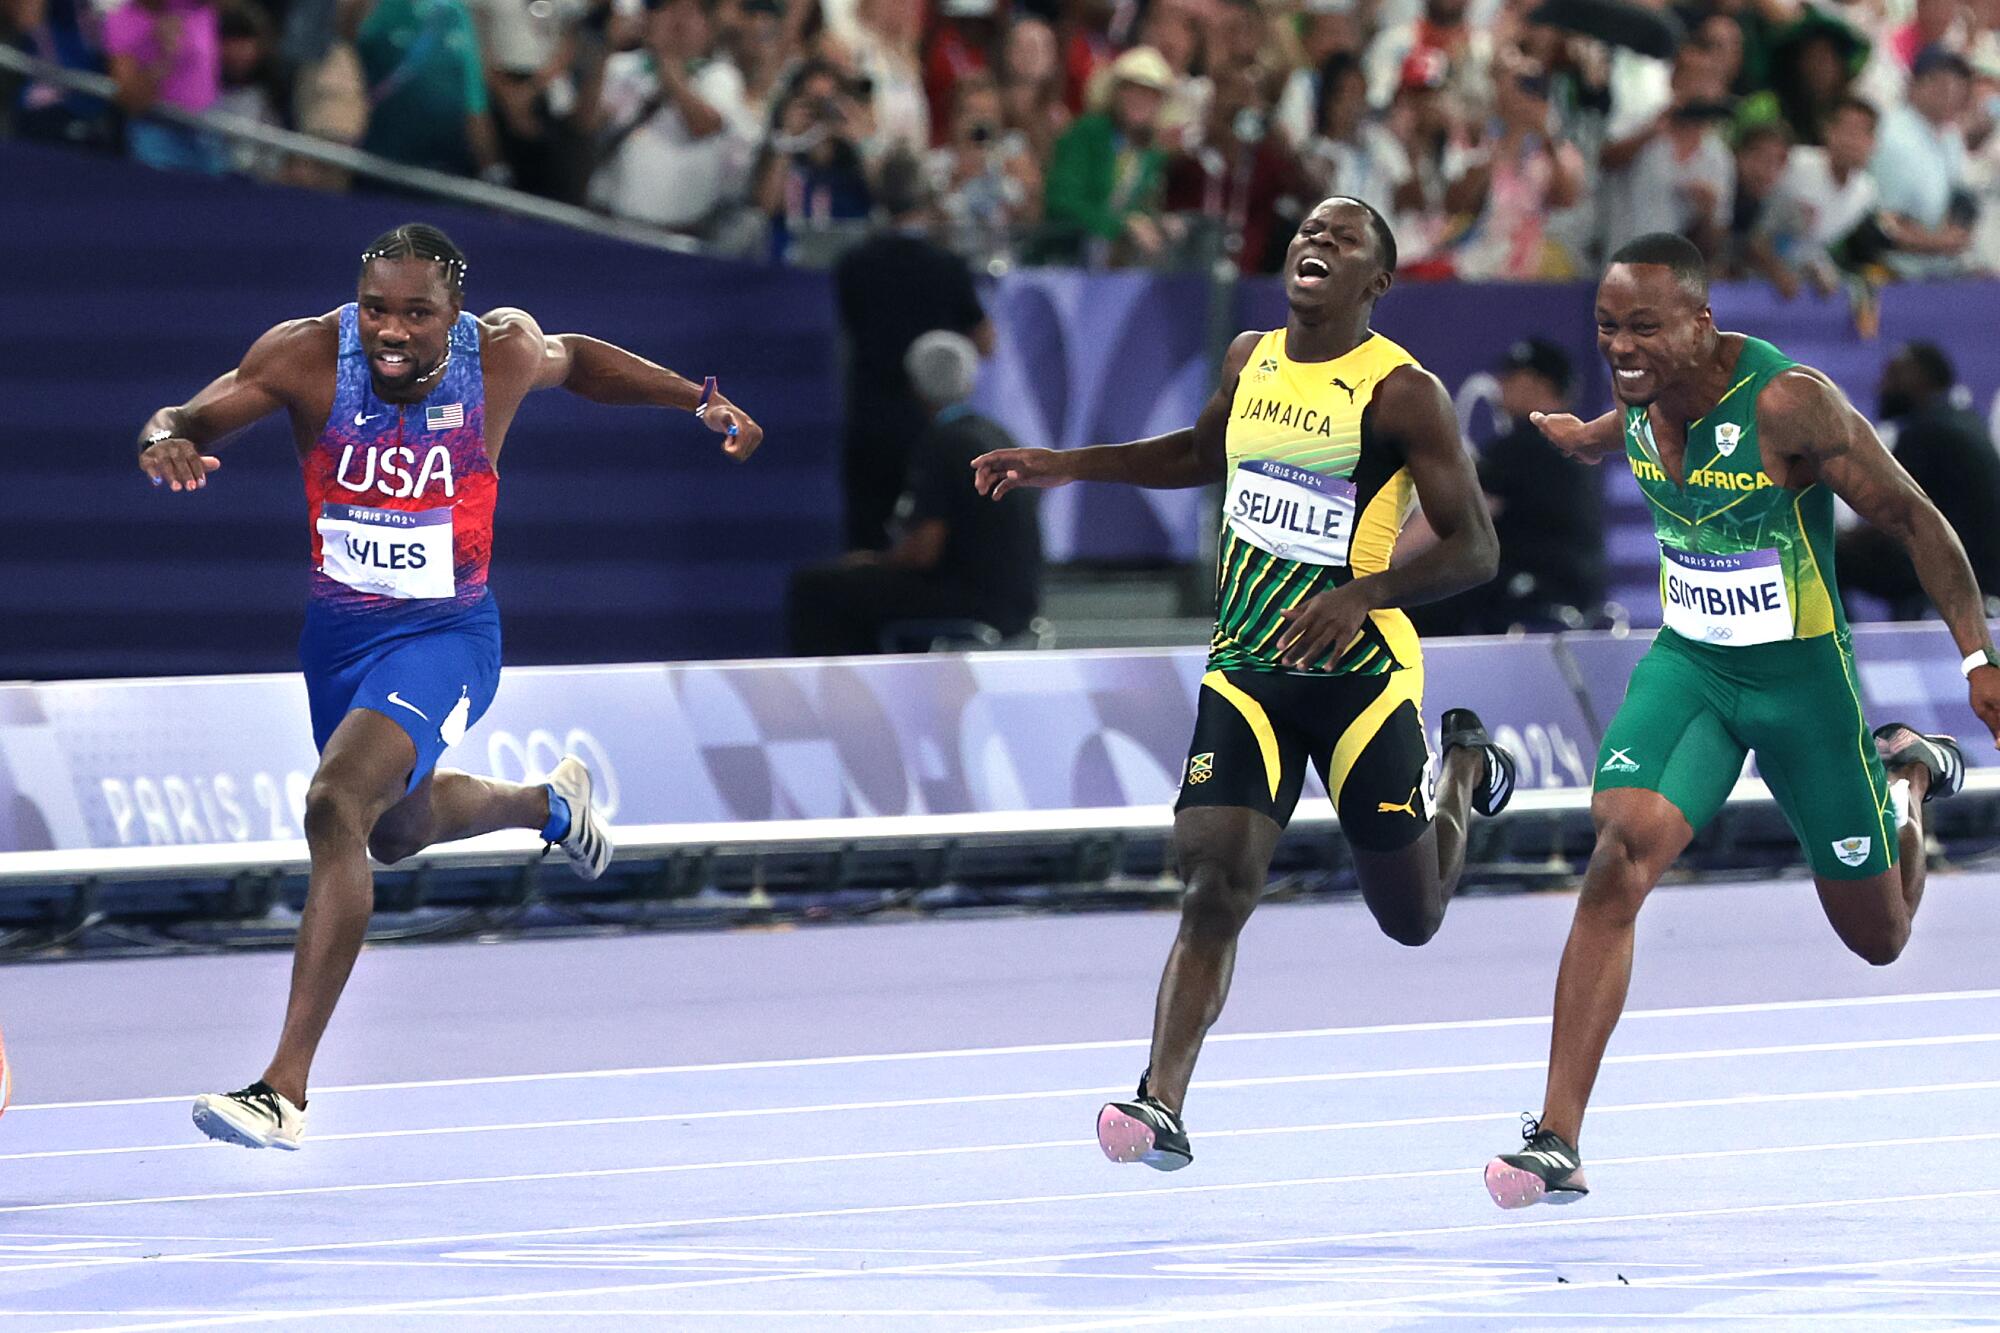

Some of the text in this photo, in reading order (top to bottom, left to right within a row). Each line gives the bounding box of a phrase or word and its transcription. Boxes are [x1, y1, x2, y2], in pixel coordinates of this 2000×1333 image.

[1240, 397, 1331, 437] JAMAICA
[336, 444, 455, 499] USA
[1262, 461, 1322, 486] PARIS 2024
[1685, 469, 1775, 491] AFRICA
[348, 509, 416, 525] PARIS 2024
[1233, 489, 1343, 539] SEVILLE
[1679, 554, 1741, 568] PARIS 2024
[1668, 574, 1781, 616] SIMBINE
[1494, 722, 1588, 787] 024
